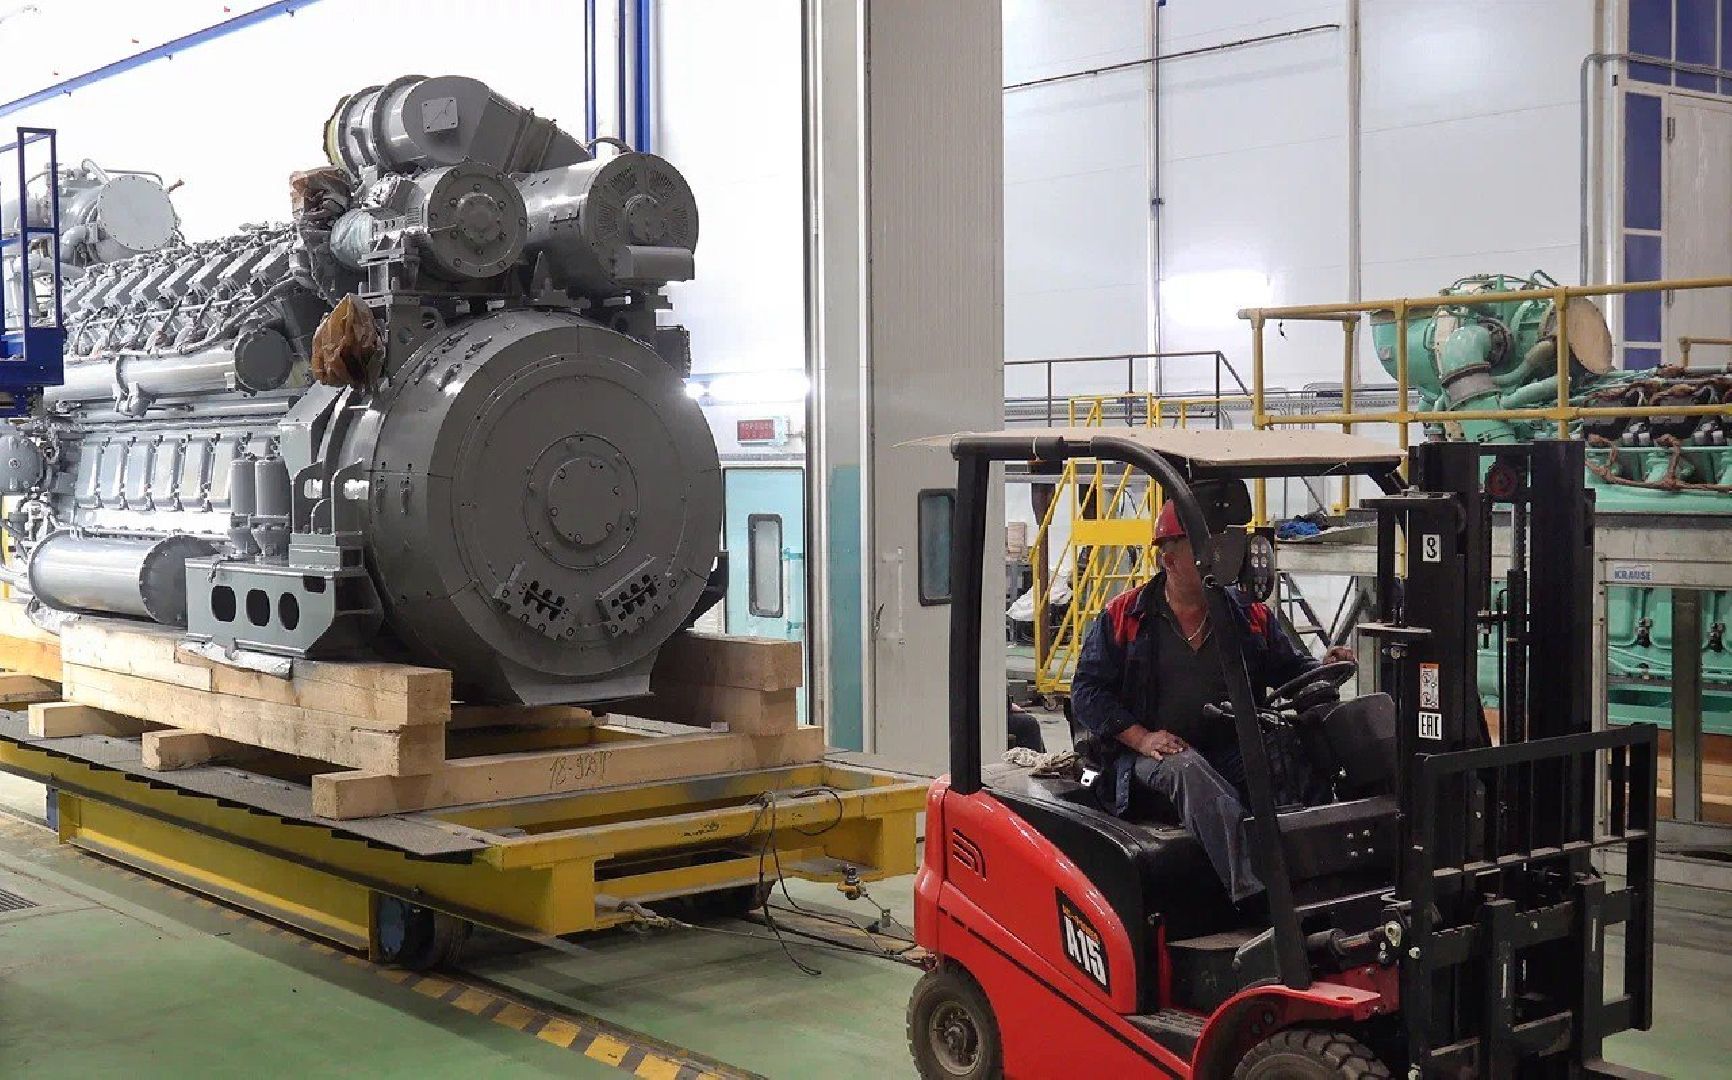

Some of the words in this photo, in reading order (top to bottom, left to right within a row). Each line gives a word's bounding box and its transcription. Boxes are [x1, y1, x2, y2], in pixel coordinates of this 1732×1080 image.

[1614, 570, 1651, 580] KRAUSE
[1421, 714, 1440, 738] EAC
[1063, 915, 1107, 986] A15
